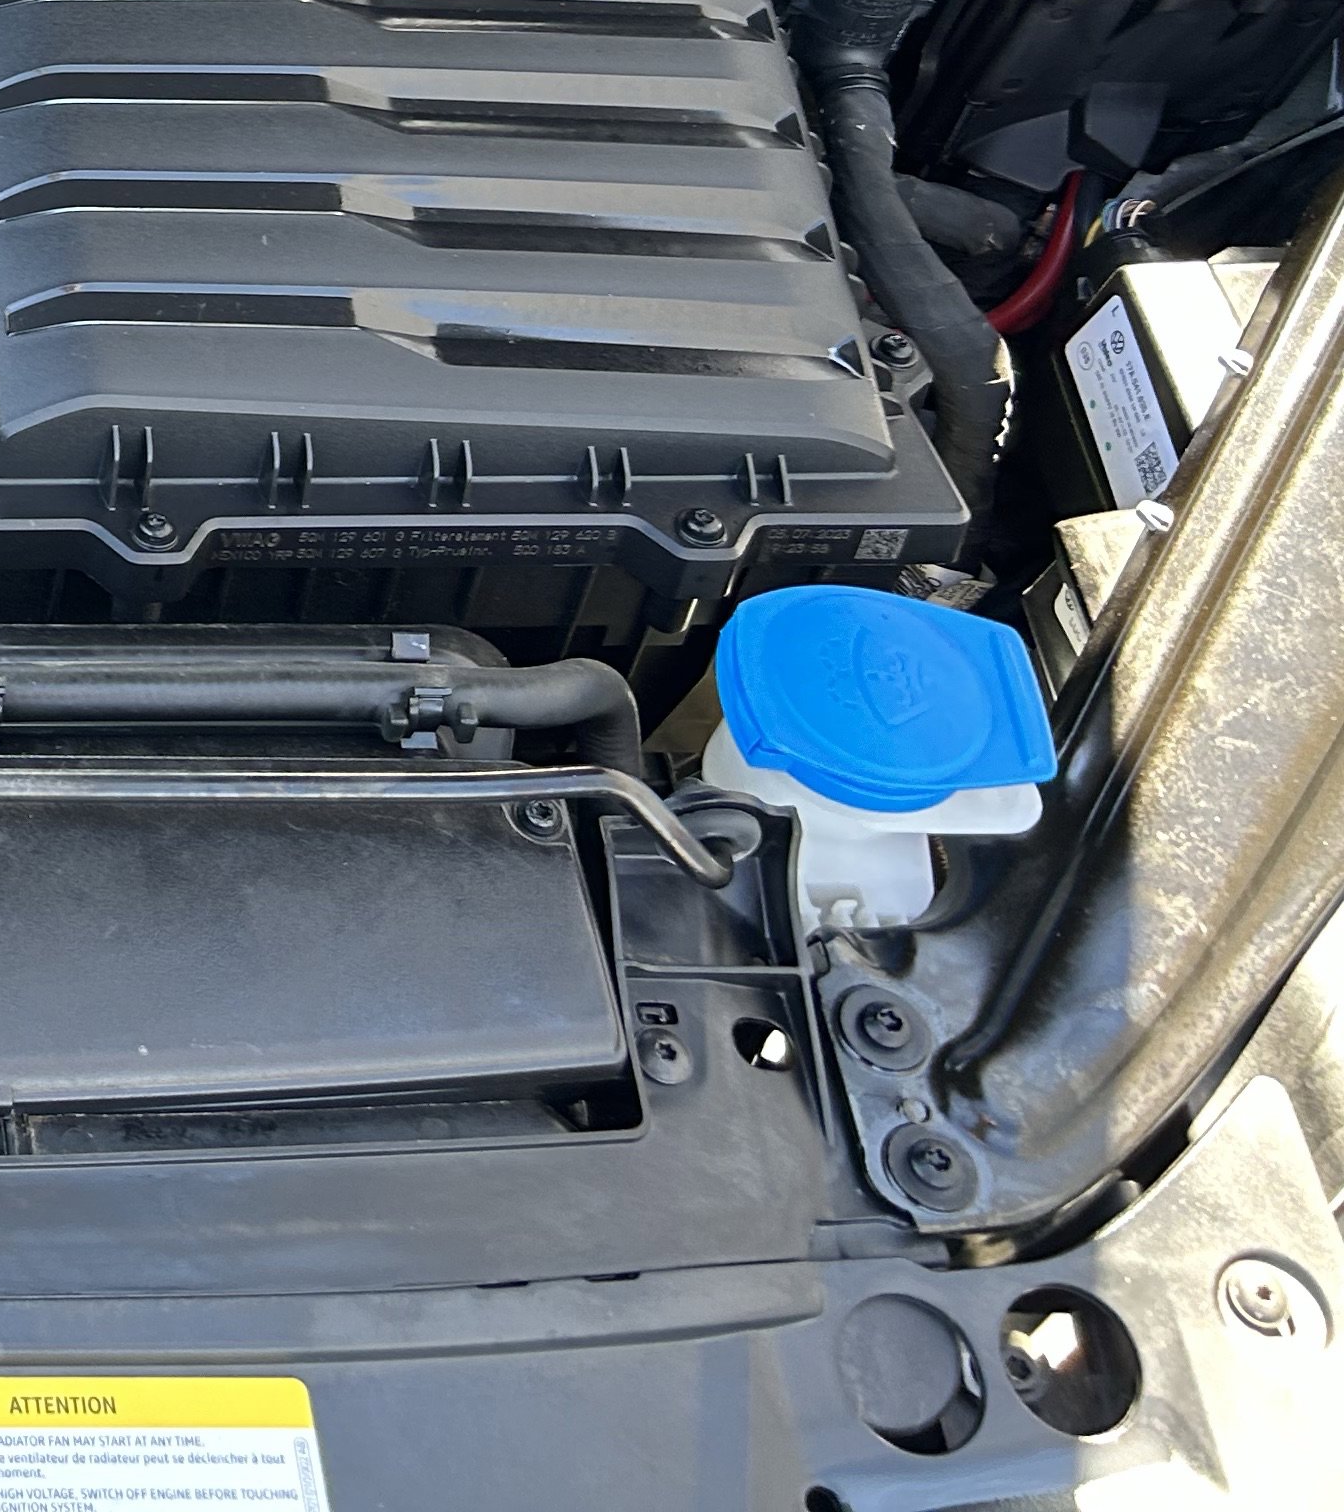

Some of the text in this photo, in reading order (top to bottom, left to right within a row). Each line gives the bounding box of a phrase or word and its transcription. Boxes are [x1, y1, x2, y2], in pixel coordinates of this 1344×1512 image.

[334, 531, 358, 543] 129
[9, 1395, 118, 1415] ATTENTION
[48, 1435, 70, 1448] FAN
[73, 1435, 96, 1448] MAY
[100, 1435, 132, 1448] START
[134, 1436, 148, 1448] AT
[150, 1436, 173, 1448] ANY
[175, 1435, 206, 1448] TIME.
[8, 1452, 69, 1465] ventilateur
[72, 1452, 86, 1464] de
[88, 1452, 140, 1465] radiateur
[144, 1454, 168, 1467] peut
[172, 1456, 185, 1465] se
[187, 1452, 248, 1465] déclencher
[251, 1452, 259, 1465] à
[261, 1454, 286, 1465] tout
[81, 1488, 124, 1500] SWITCH
[126, 1488, 148, 1500] OFF
[150, 1489, 192, 1501] ENGINE
[194, 1489, 238, 1501] BEFORE
[241, 1489, 299, 1501] TOUCHING
